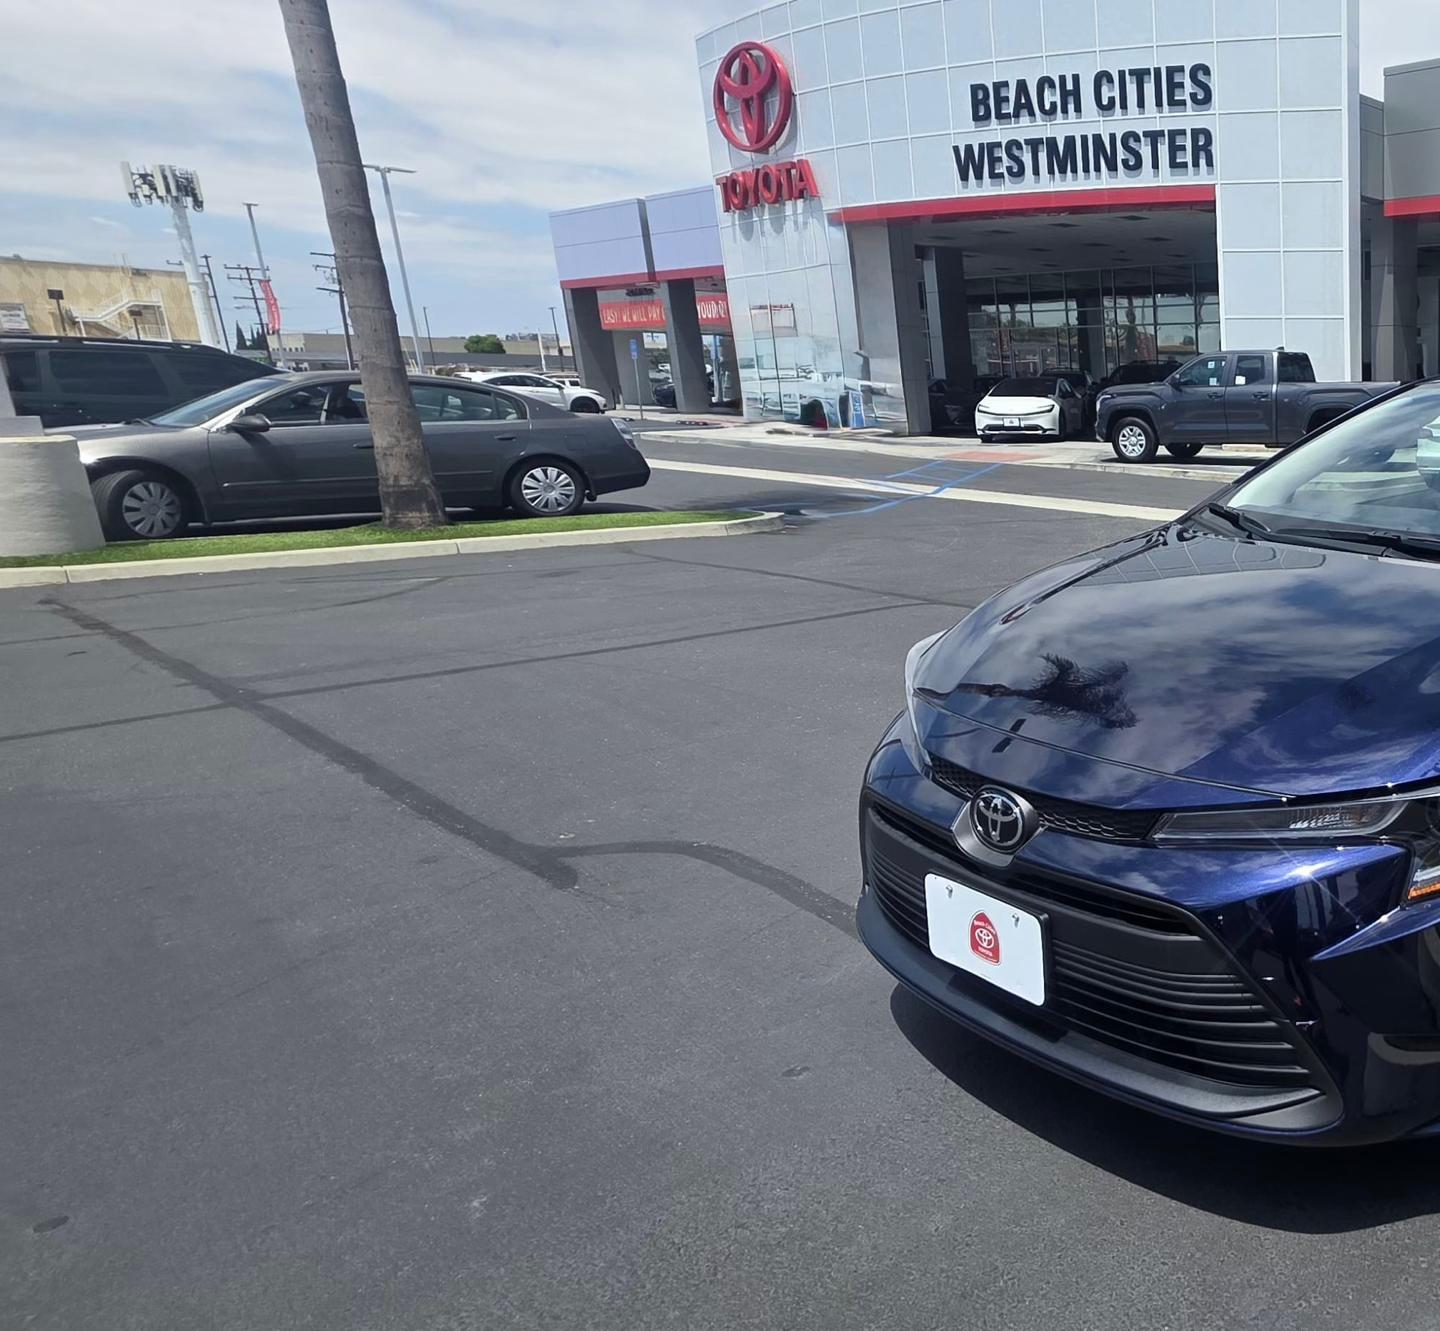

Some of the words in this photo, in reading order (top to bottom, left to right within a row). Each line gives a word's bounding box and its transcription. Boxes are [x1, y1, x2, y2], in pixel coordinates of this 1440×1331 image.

[970, 72, 1082, 122] BEACH
[1093, 63, 1213, 112] CITIES
[952, 127, 1214, 182] WESTMINSTER
[715, 159, 821, 213] TOYOTA
